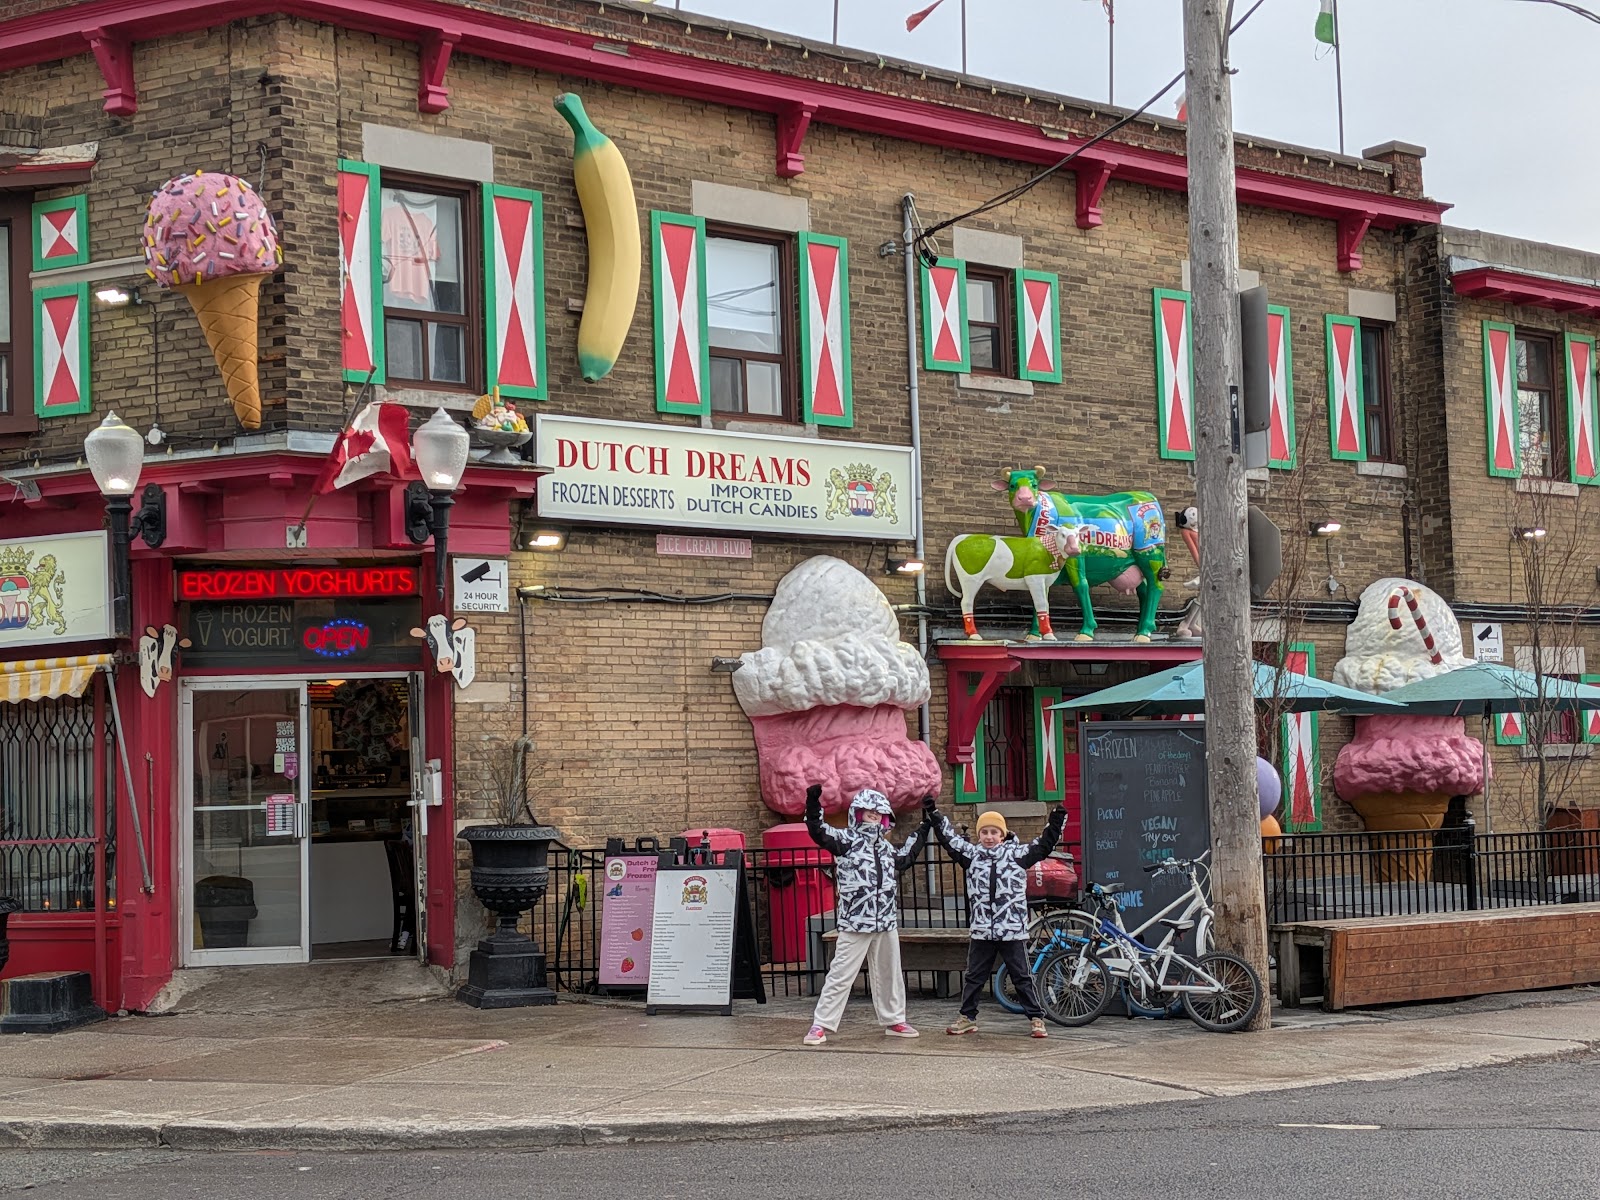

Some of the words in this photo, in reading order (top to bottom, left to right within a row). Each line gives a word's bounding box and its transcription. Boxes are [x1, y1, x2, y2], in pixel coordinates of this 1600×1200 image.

[555, 438, 670, 476] DUTCH
[684, 449, 812, 487] DREAMS
[552, 482, 609, 507] FROZEN
[613, 486, 674, 510] DESSERTS
[711, 484, 792, 503] IMPORTED
[687, 498, 744, 515] DUTCH
[749, 502, 818, 519] CANDIES
[664, 537, 683, 554] ICE
[686, 538, 719, 555] CREAM
[723, 539, 746, 556] BLVD
[1096, 531, 1133, 549] DREAMS
[283, 569, 414, 594] YOGHURTS
[463, 592, 473, 600] 24
[475, 592, 498, 601] HOUR
[222, 606, 291, 623] FROZEN
[461, 602, 501, 611] SECURITY
[222, 628, 291, 647] YOGURT
[303, 627, 370, 650] OPEN
[1141, 816, 1177, 831] VEGAN
